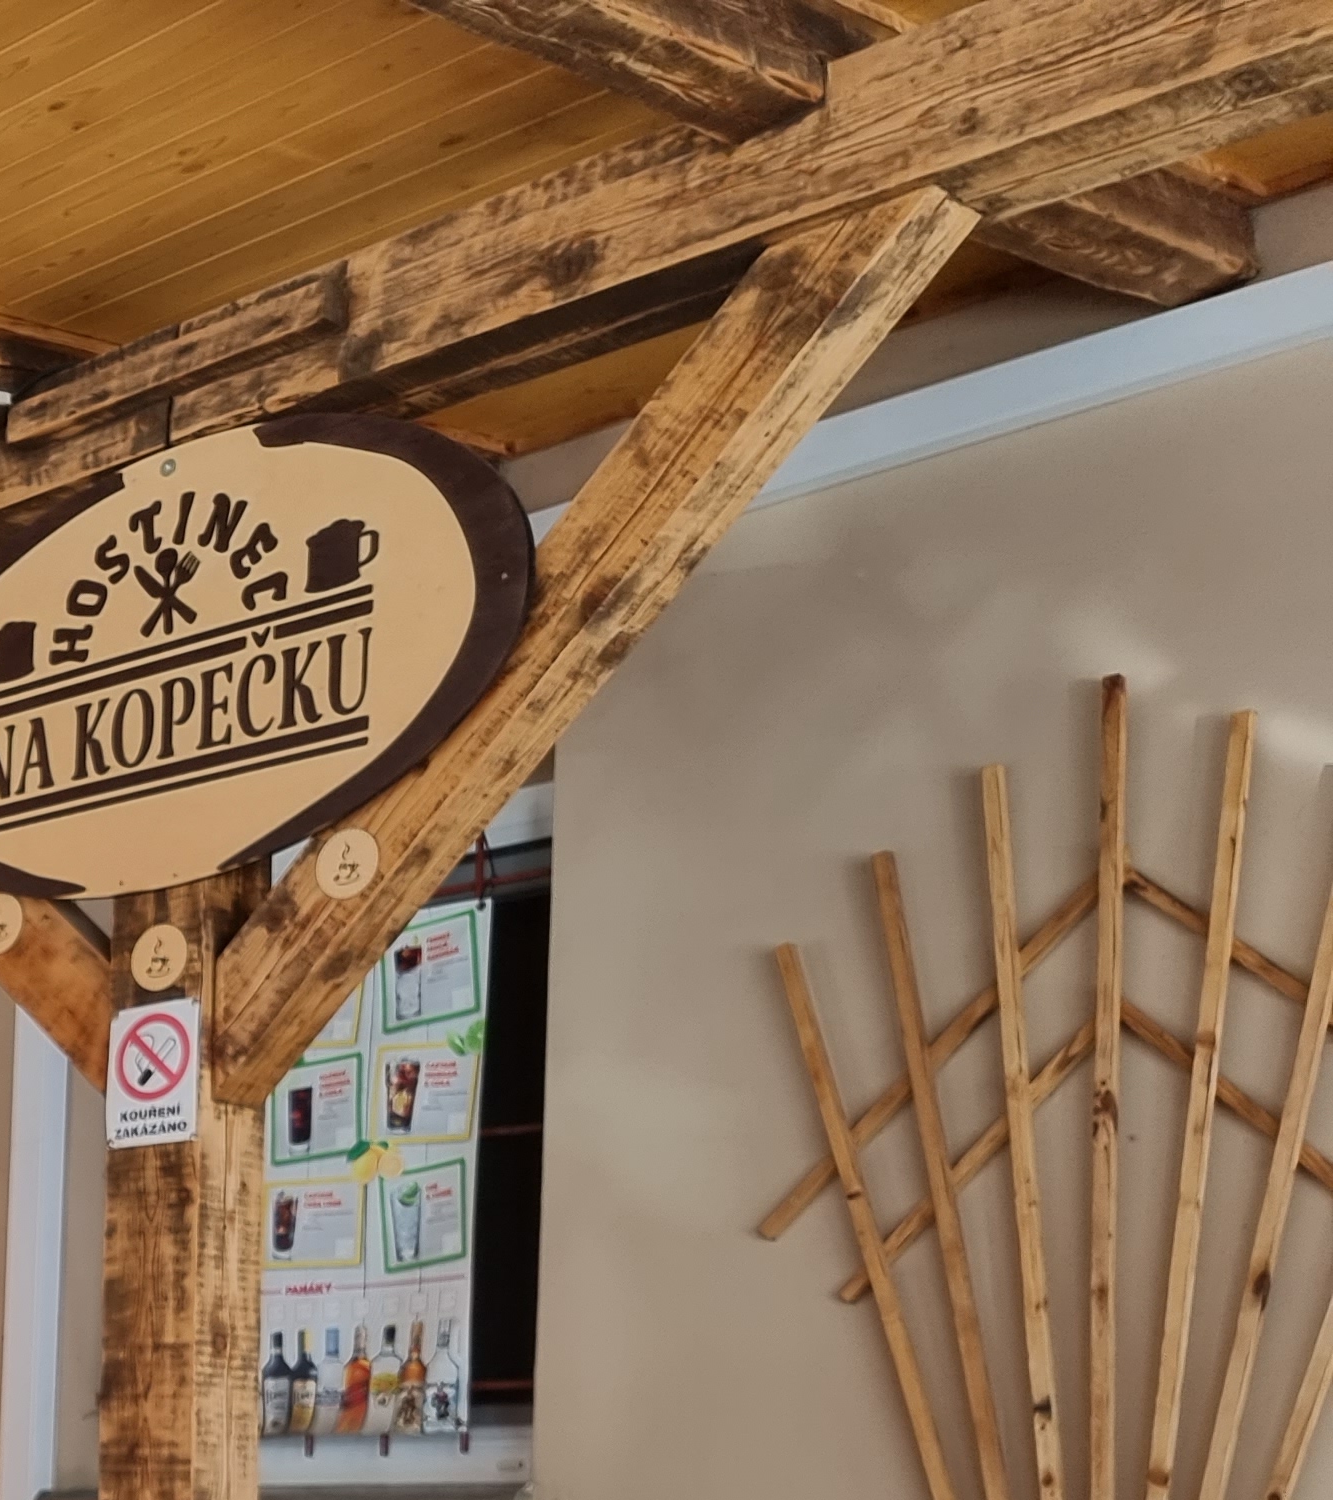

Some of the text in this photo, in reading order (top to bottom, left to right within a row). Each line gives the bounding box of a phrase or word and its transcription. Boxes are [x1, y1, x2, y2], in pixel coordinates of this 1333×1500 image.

[49, 491, 286, 664] HOSTINEC
[71, 626, 373, 781] KOPEČKU
[114, 1120, 188, 1140] ZAKÁZÁNO
[120, 1103, 181, 1122] KOUŘENÍ
